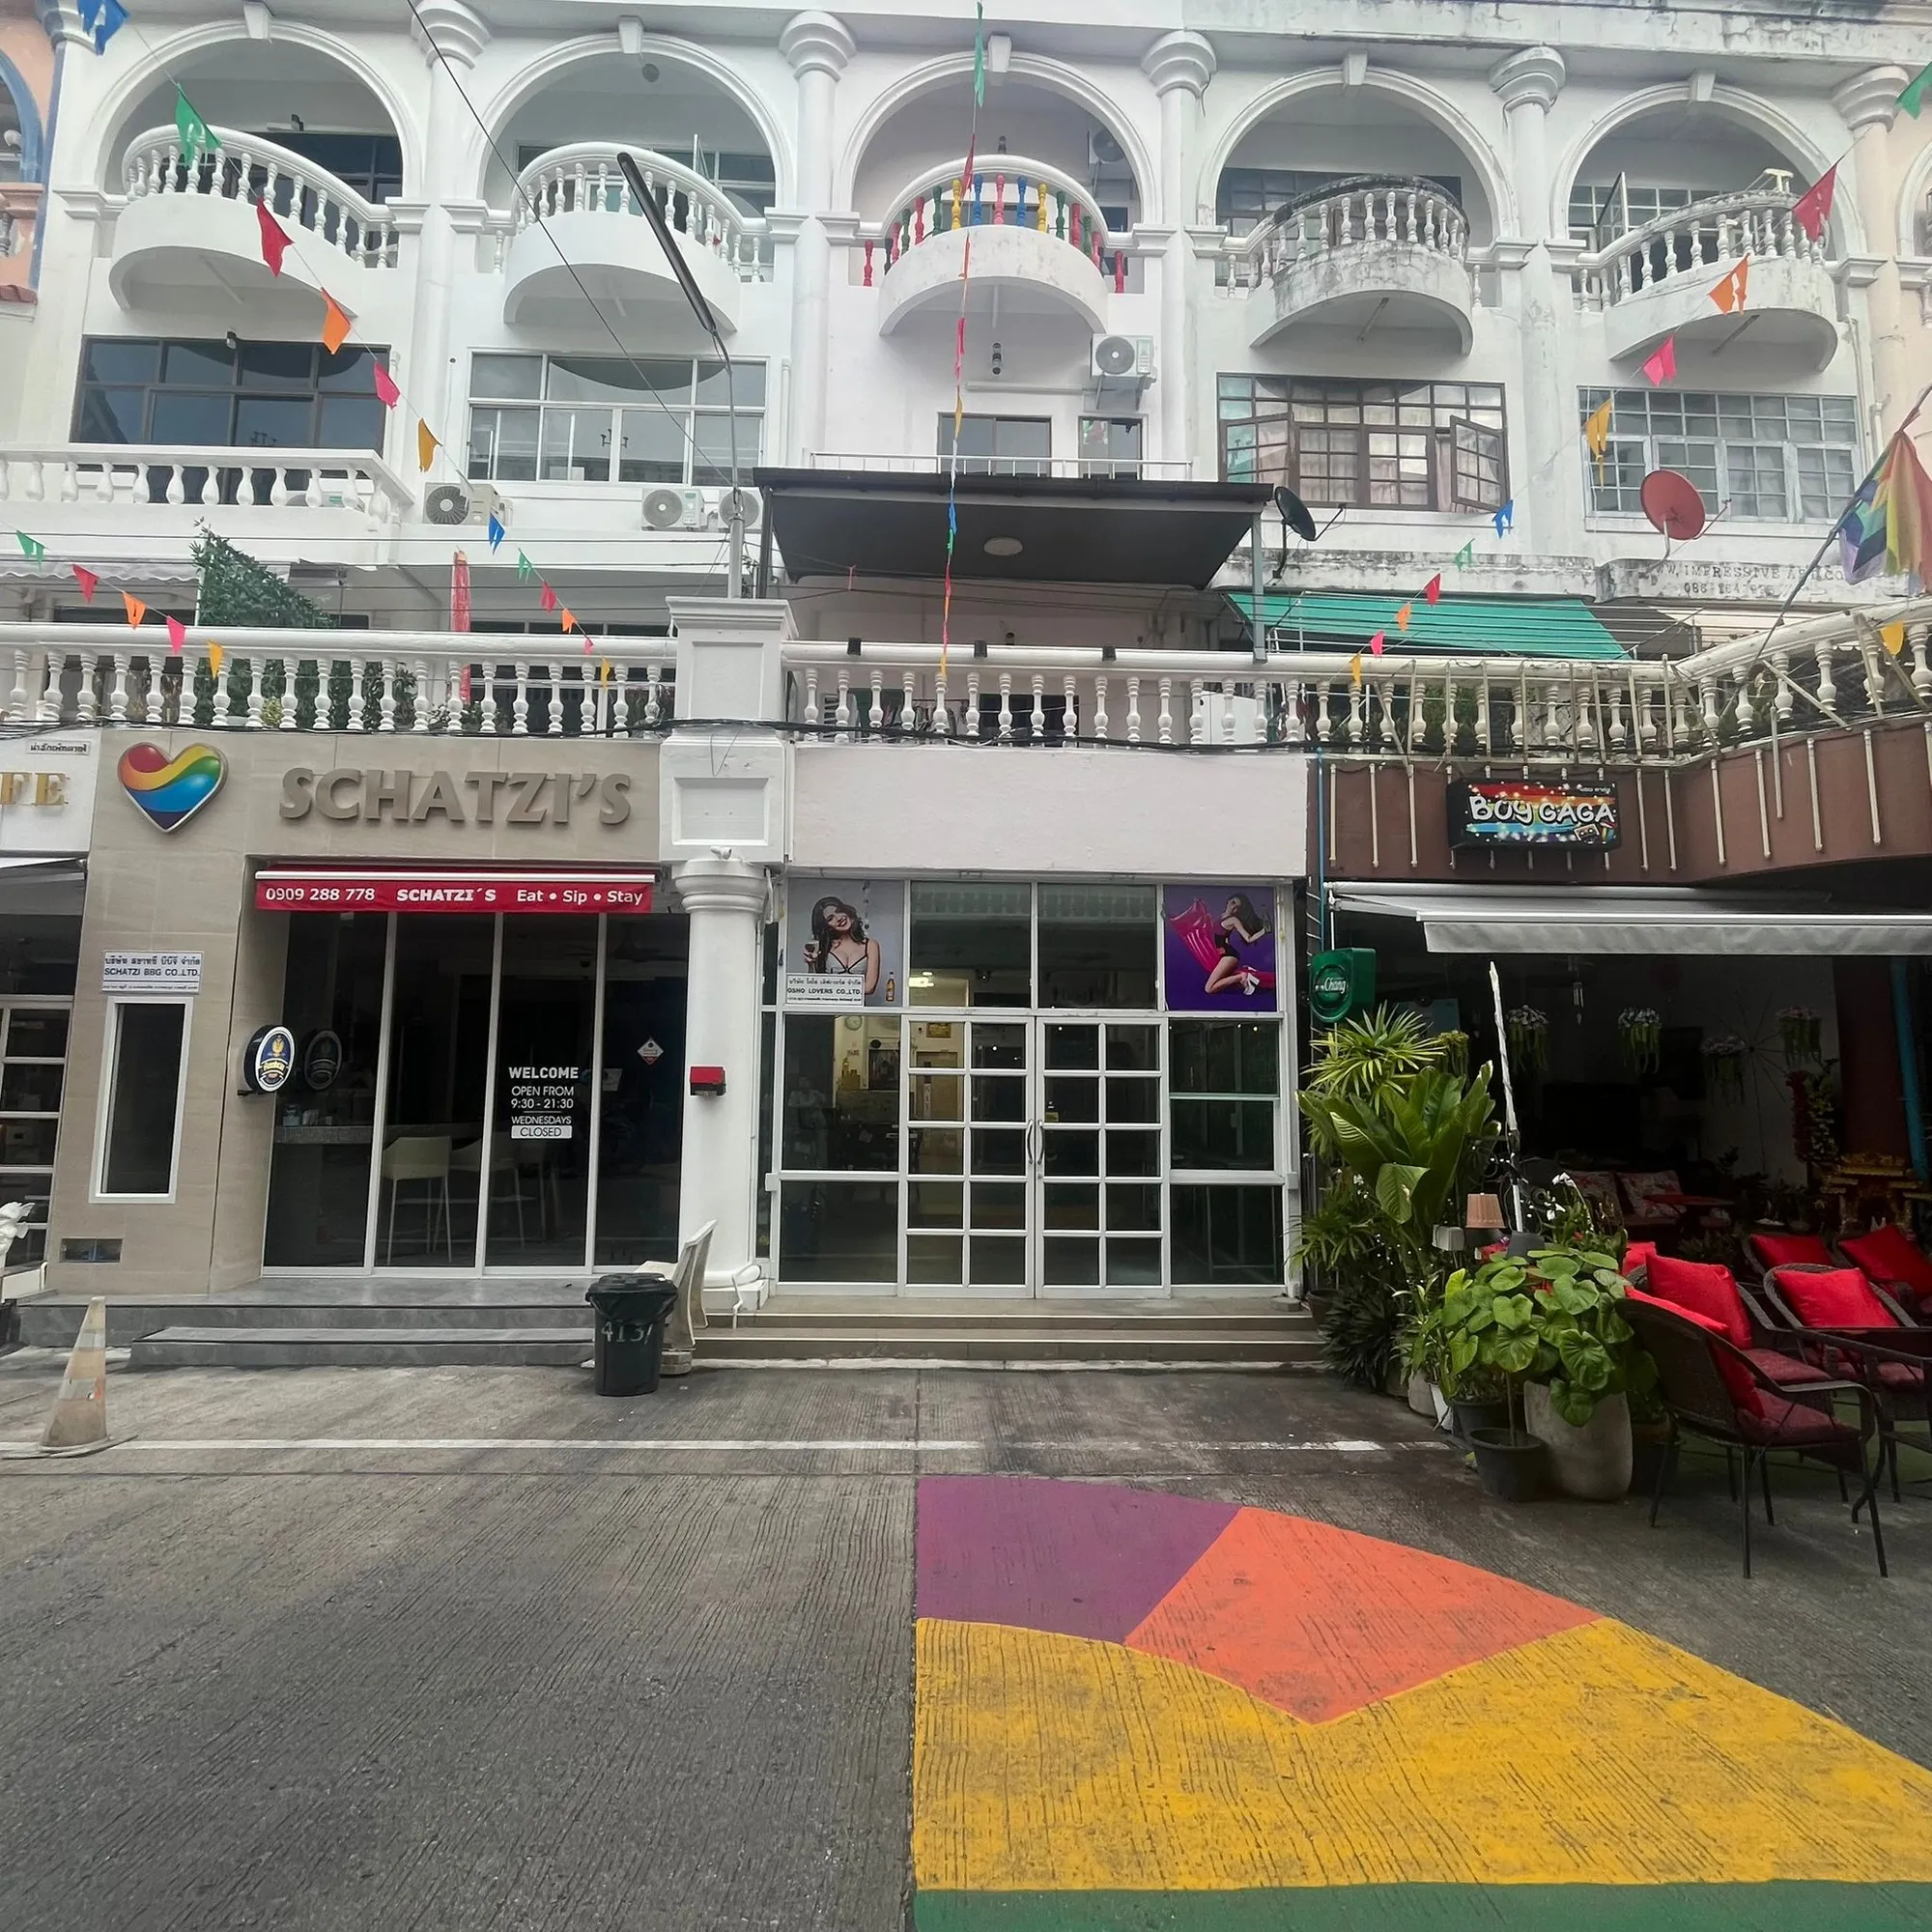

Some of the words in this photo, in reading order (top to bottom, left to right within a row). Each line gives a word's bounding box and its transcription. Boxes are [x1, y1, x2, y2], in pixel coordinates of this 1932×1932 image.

[279, 767, 631, 826] SCHATZI'S
[1539, 803, 1615, 823] GAGA
[266, 888, 304, 901] 0909
[309, 888, 340, 901] 288
[346, 888, 376, 901] 778
[517, 889, 544, 902] Eat
[562, 890, 587, 905] Sip
[607, 890, 643, 905] Stay
[104, 967, 140, 976] SCHATZI
[508, 1066, 580, 1079] WELCOME
[511, 1086, 541, 1096] OPEN
[543, 1086, 575, 1096] FROM
[511, 1098, 535, 1109] 9:30
[543, 1098, 574, 1109] 21:30
[511, 1116, 572, 1125] WEDNESDAYS
[520, 1126, 562, 1137] CLOSED
